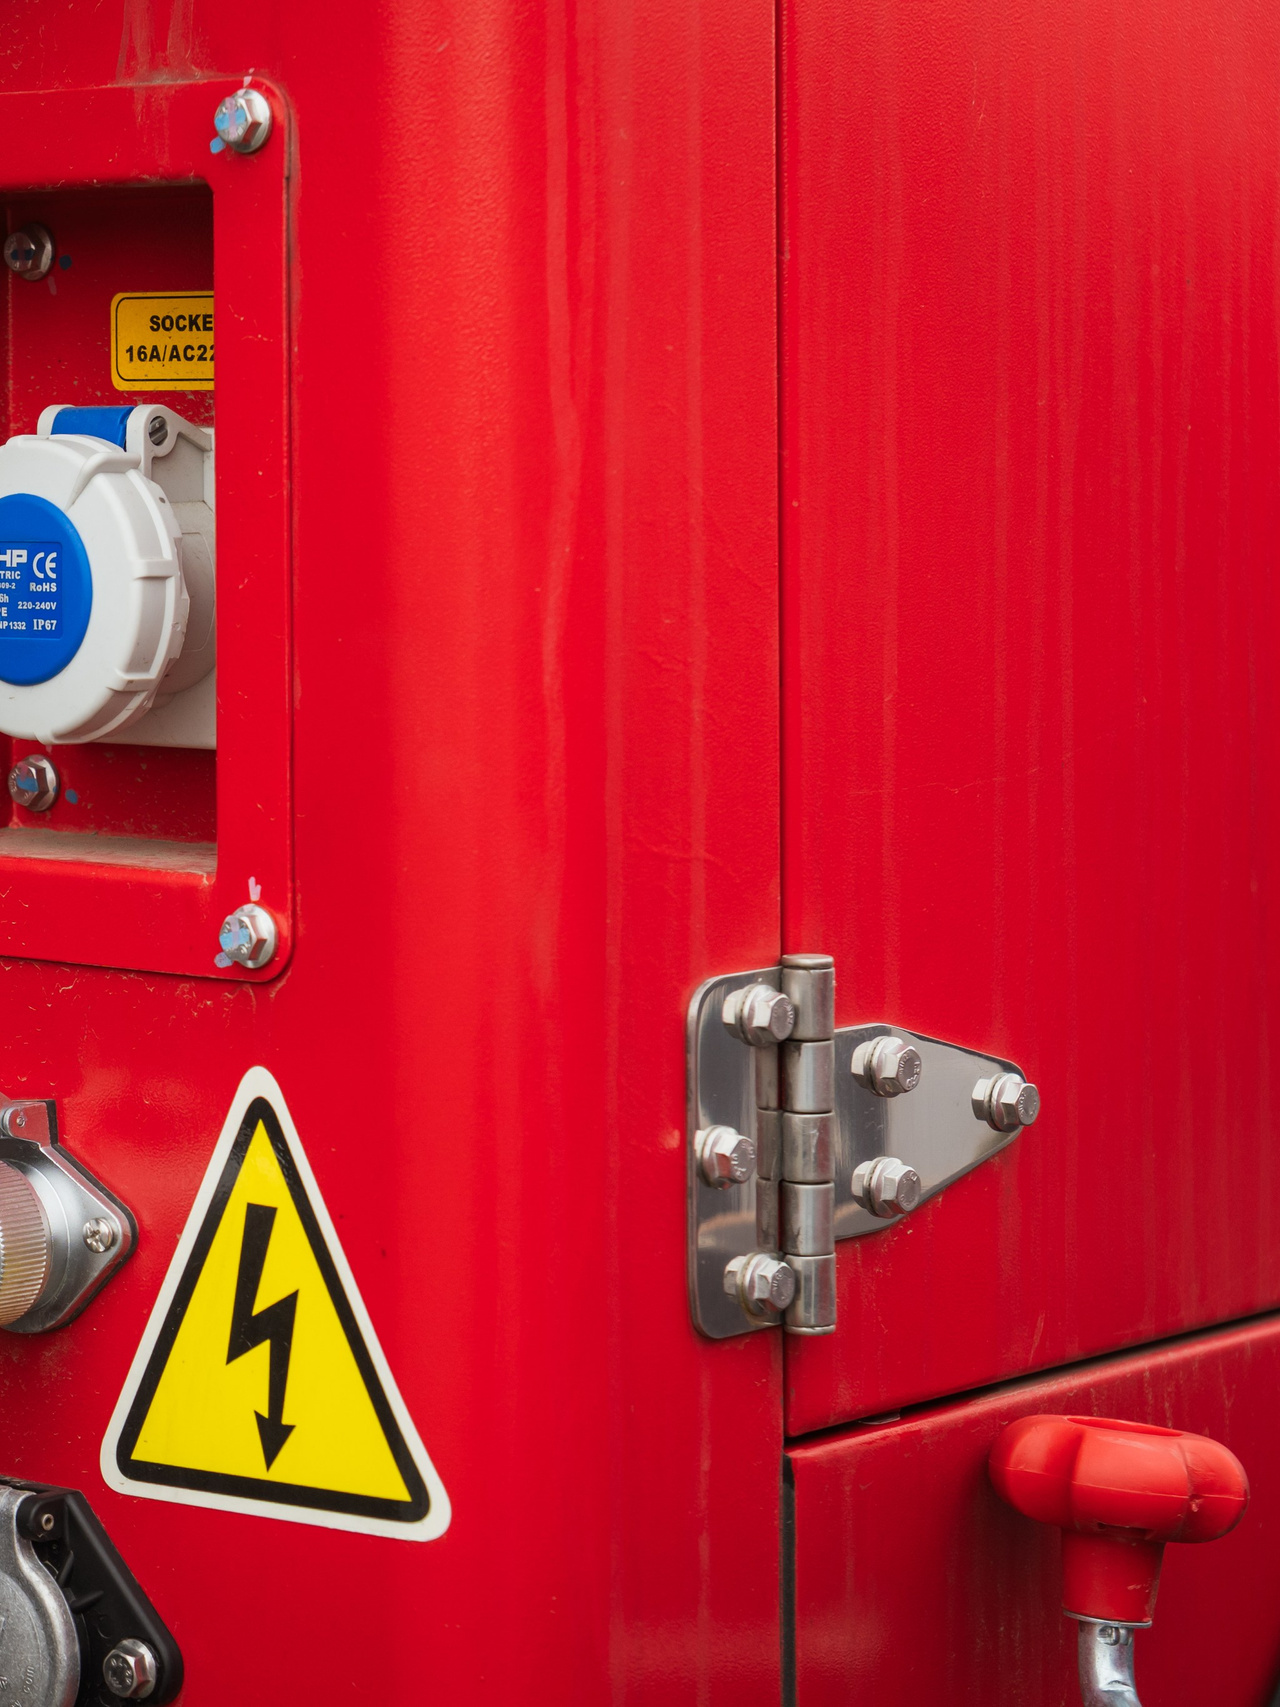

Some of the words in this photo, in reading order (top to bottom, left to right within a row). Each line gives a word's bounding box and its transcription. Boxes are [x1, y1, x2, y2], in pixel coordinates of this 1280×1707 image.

[149, 314, 213, 332] SOCKE
[32, 552, 57, 579] CE
[29, 582, 57, 592] RoHS
[17, 601, 57, 610] 220-240V
[32, 619, 57, 631] IP67
